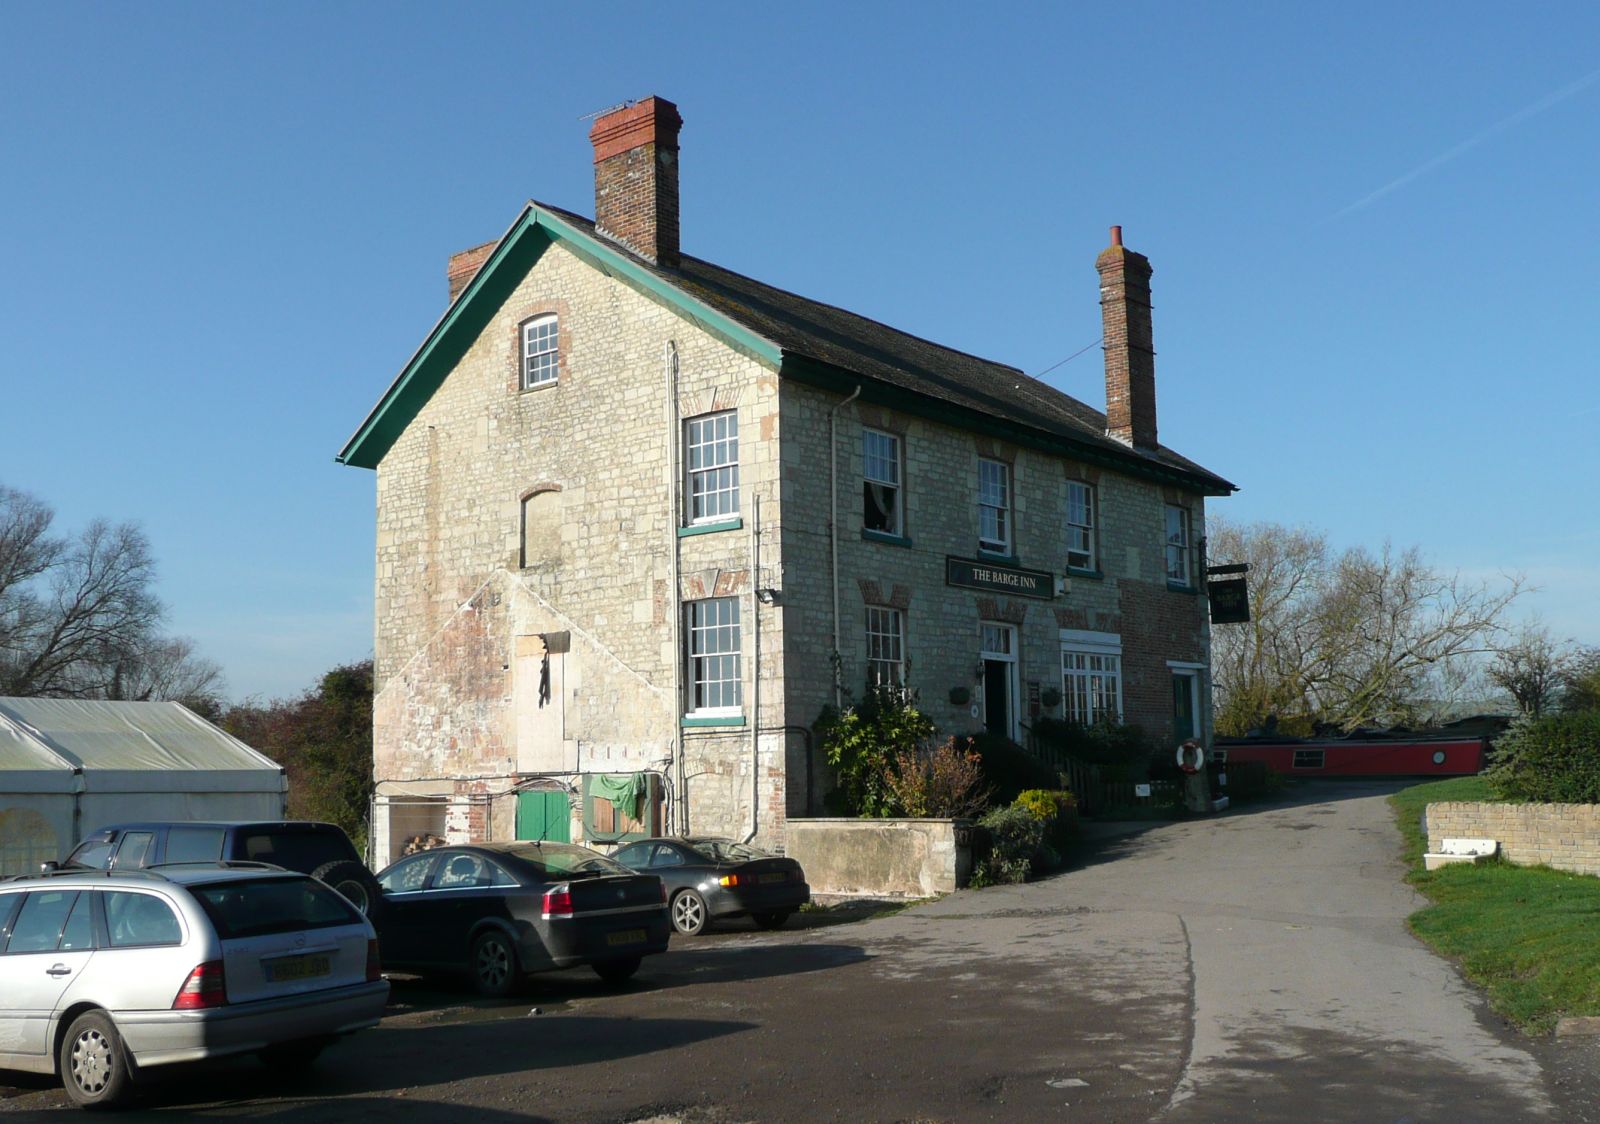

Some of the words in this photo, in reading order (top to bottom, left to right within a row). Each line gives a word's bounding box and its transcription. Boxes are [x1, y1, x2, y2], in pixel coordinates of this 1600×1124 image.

[972, 568, 991, 582] THE
[992, 571, 1018, 587] BARGE
[1020, 575, 1036, 589] INN
